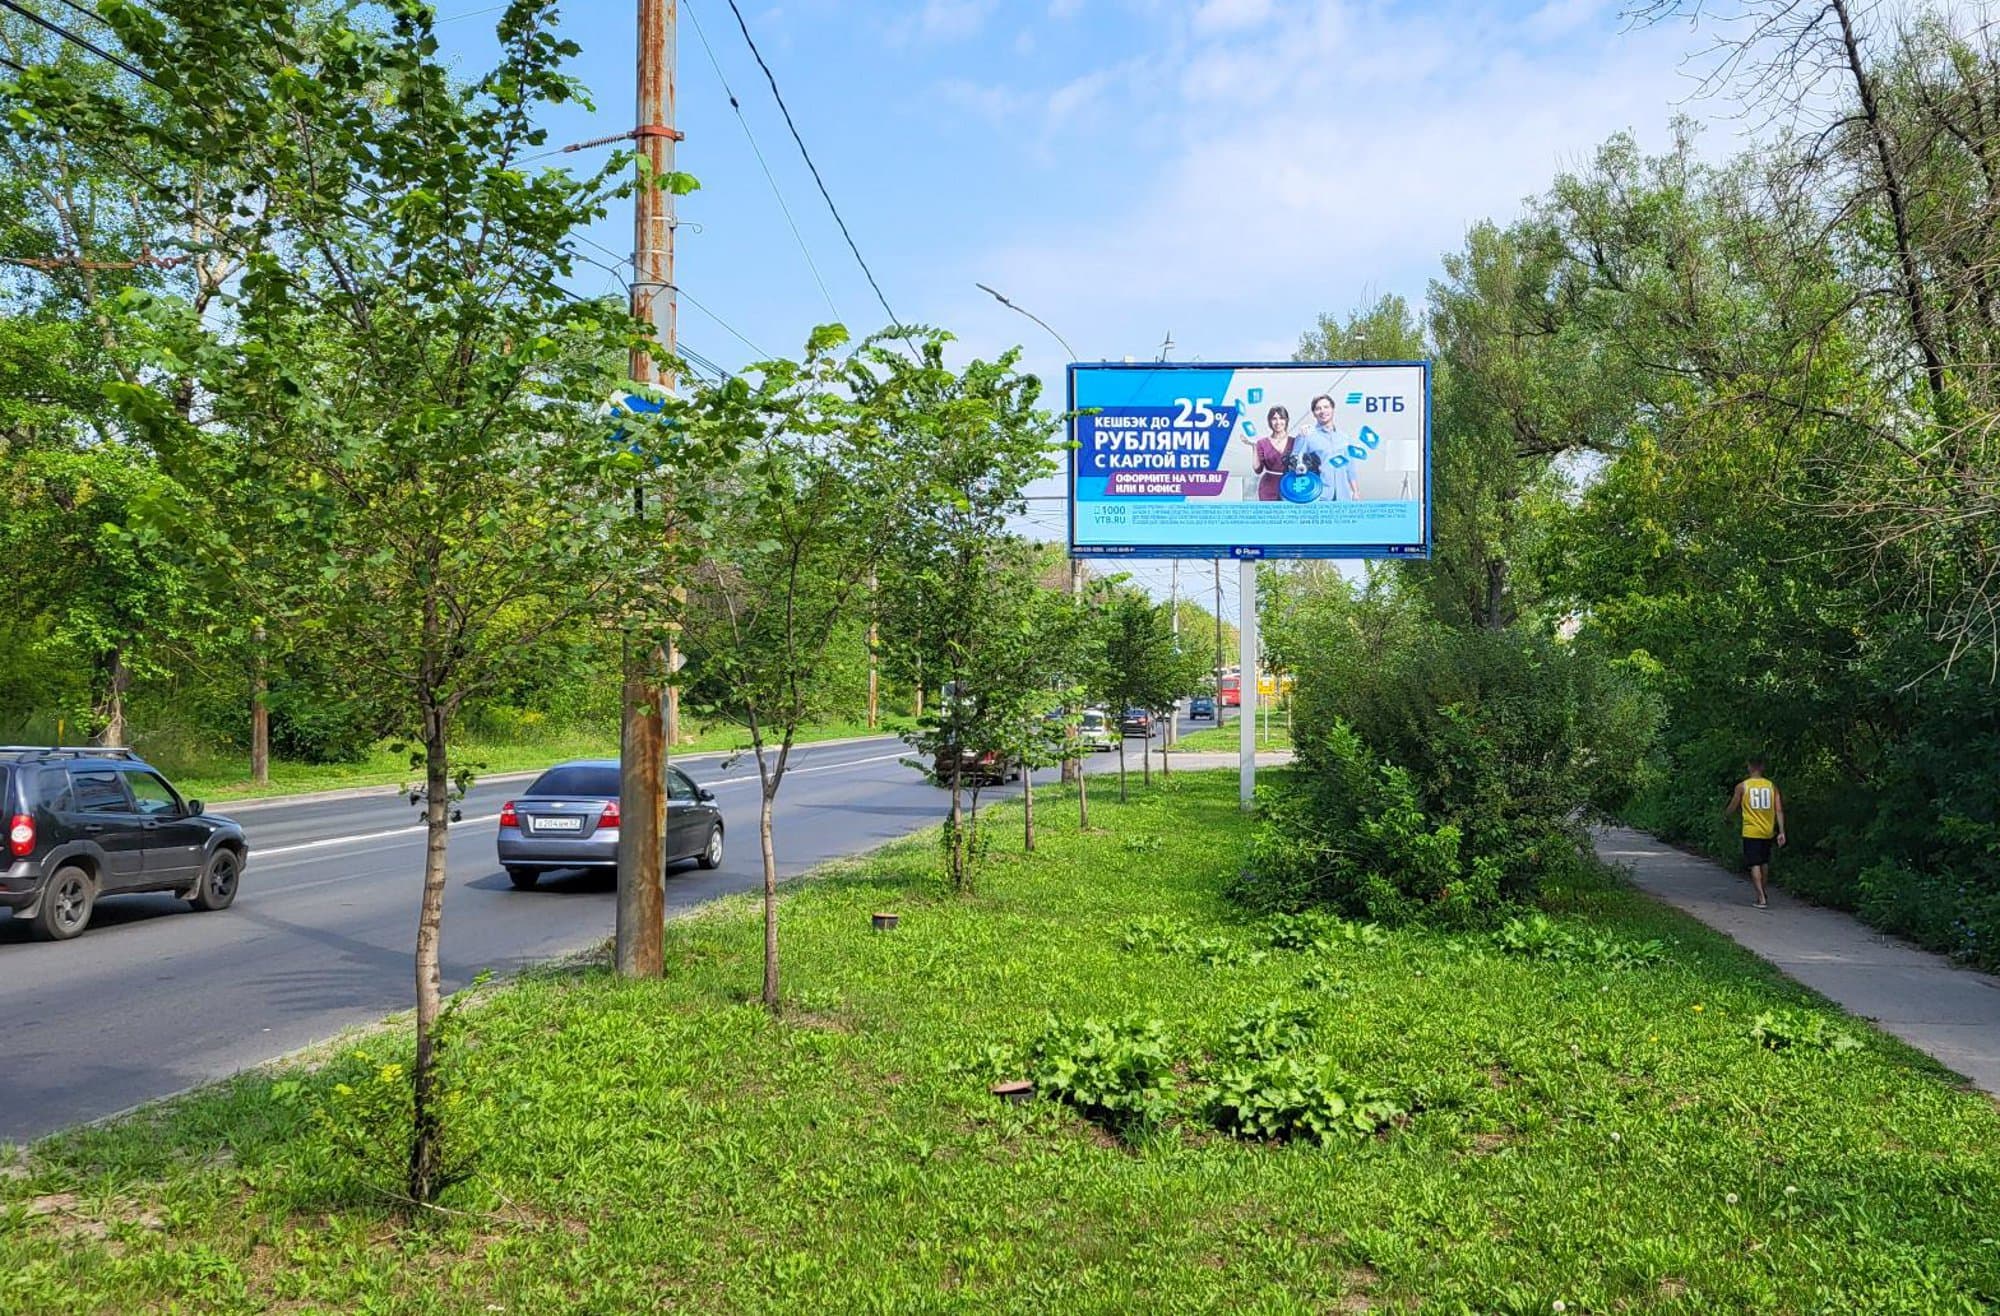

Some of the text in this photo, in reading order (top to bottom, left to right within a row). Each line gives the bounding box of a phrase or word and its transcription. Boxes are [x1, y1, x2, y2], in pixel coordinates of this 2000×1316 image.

[1366, 396, 1405, 413] ВТБ
[1094, 416, 1148, 428] КЕШБЭК
[1151, 416, 1171, 430] ДО
[1094, 431, 1210, 450] РУБЛЯМИ
[1094, 451, 1210, 468] С КАРТОЙ ВТБ
[1115, 473, 1222, 483] ОФОРМИТЕ НА VTB.RU
[1115, 484, 1181, 493] ИЛИ В ОФИСЕ
[1102, 505, 1126, 515] 1000
[1094, 516, 1126, 524] VTB.RU
[1750, 787, 1771, 809] 60
